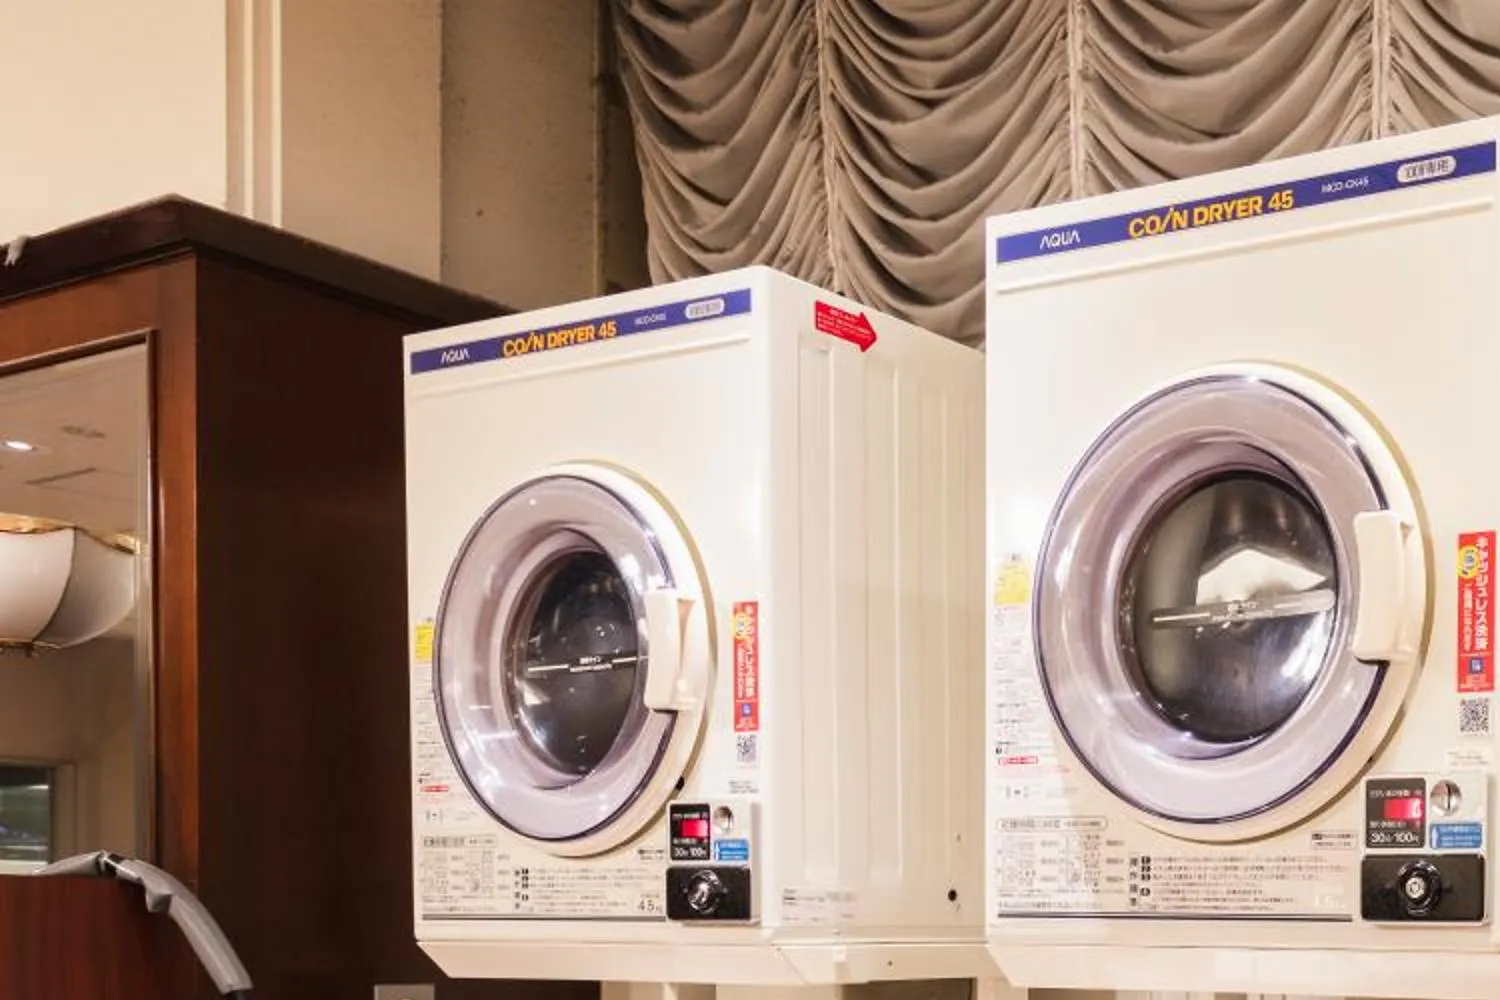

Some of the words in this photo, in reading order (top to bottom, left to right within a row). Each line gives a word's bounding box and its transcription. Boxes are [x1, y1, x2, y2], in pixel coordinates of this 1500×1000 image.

[1193, 193, 1263, 229] DRYER
[1267, 190, 1295, 211] 45
[1039, 228, 1081, 250] AQUA
[547, 324, 595, 349] DRYER
[598, 320, 617, 338] 45
[440, 347, 470, 365] AQUA
